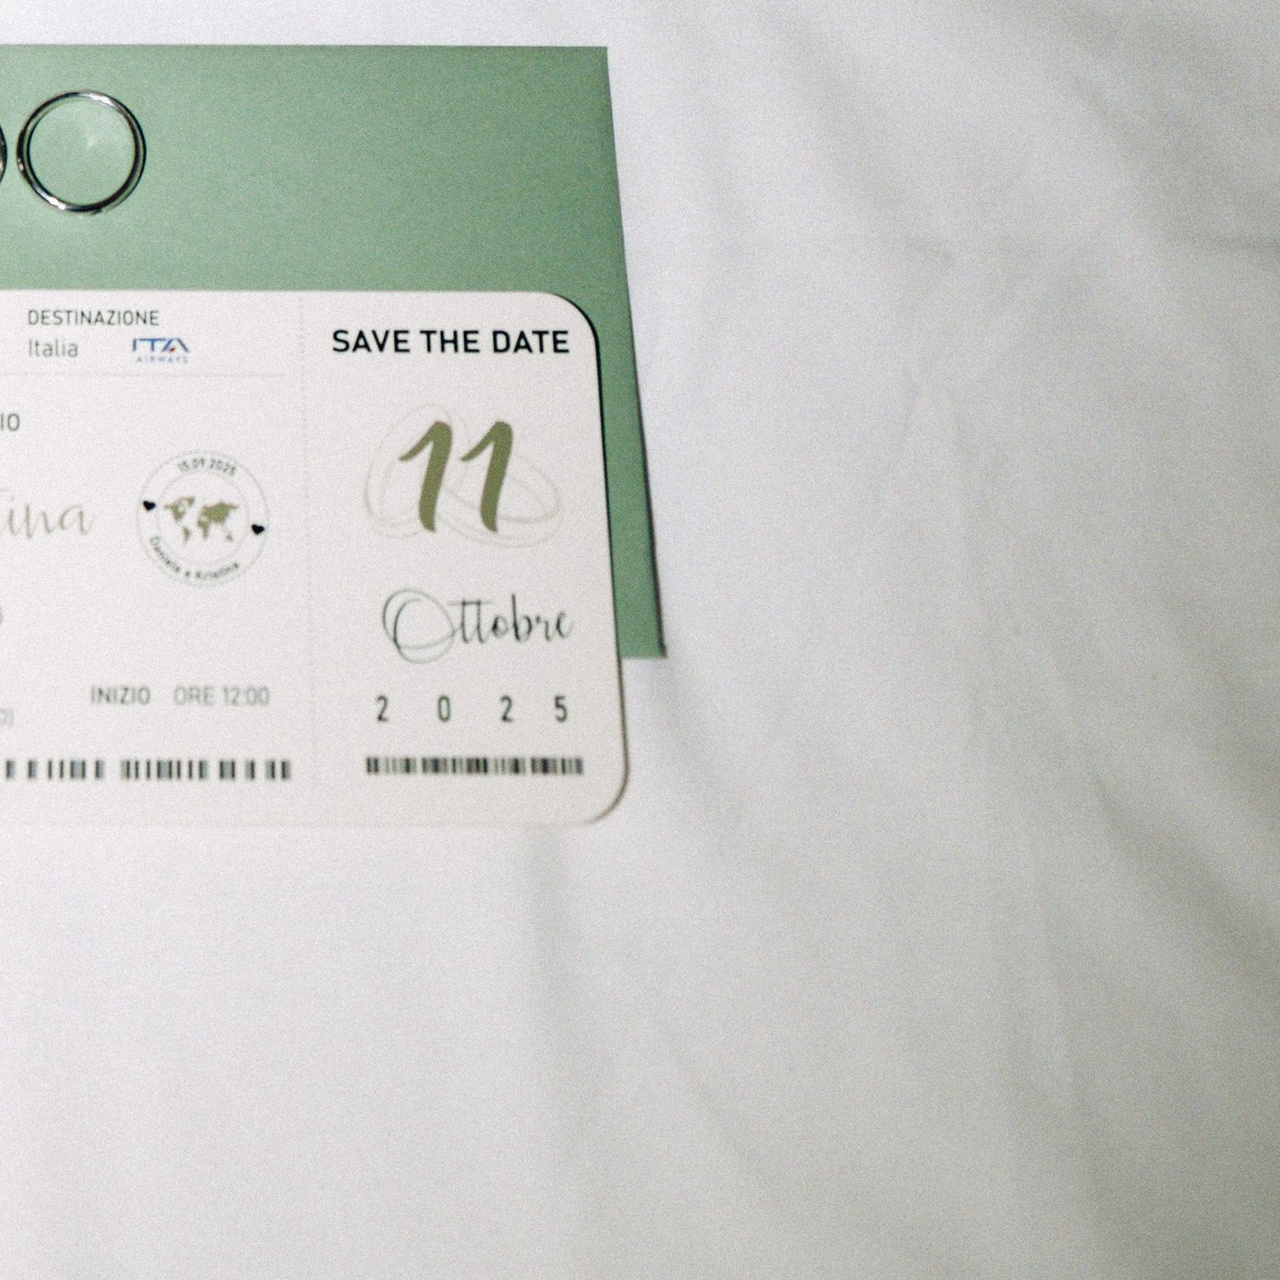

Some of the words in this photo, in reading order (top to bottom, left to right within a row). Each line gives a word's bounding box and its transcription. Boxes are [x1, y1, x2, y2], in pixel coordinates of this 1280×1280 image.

[27, 308, 160, 327] DESTINAZIONE
[27, 338, 80, 358] Italia
[131, 337, 190, 354] ITA
[331, 328, 411, 355] SAVE
[419, 328, 482, 355] THE
[491, 328, 571, 356] DATE
[135, 355, 189, 364] AIRWAYS
[397, 420, 514, 533] 11
[381, 588, 575, 664] Ottobre
[90, 685, 152, 706] INIZIO
[173, 685, 216, 707] ORE
[222, 685, 271, 707] 12:00
